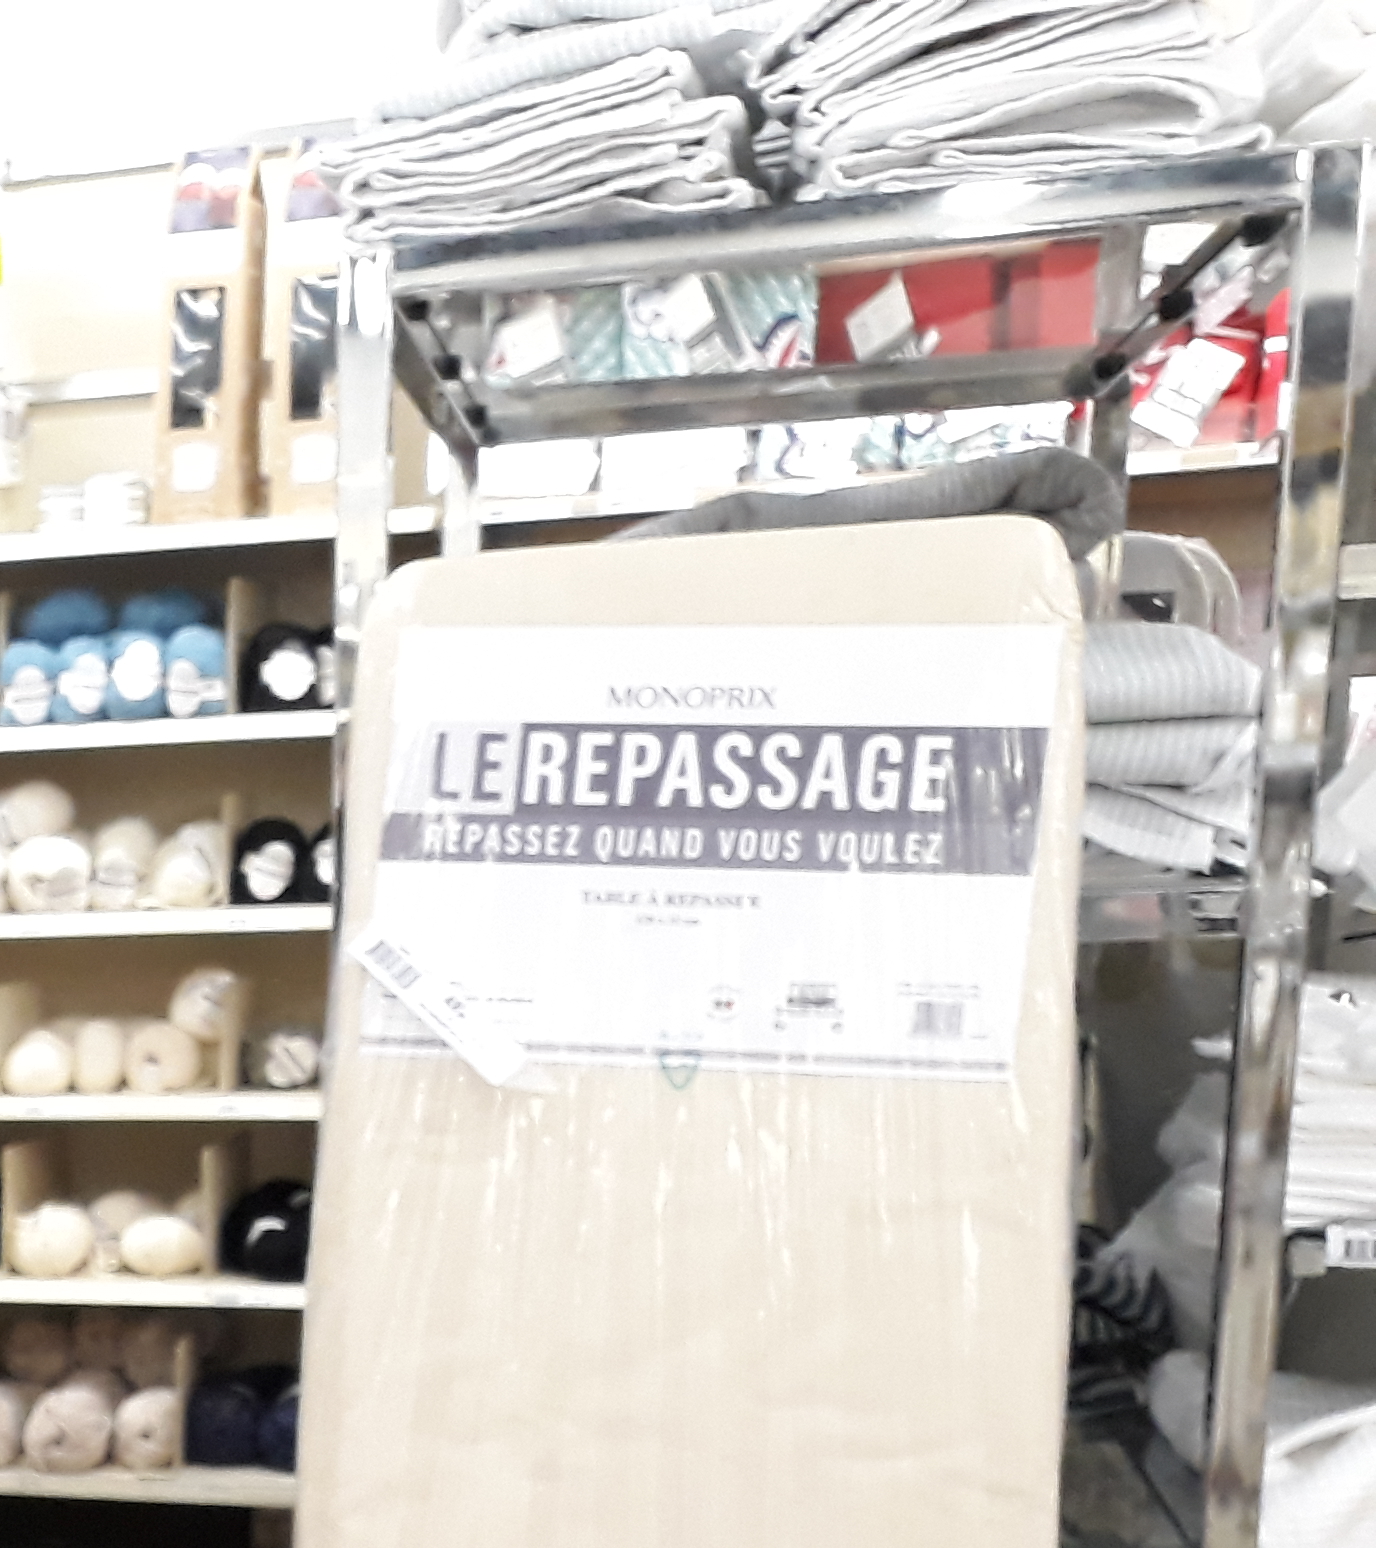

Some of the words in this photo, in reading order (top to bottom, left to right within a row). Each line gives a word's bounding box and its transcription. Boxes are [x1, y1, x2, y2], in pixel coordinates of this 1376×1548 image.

[608, 684, 778, 710] MONOPRIX
[433, 731, 508, 802] LE
[521, 730, 954, 812] REPASSAGE
[422, 821, 583, 858] REPASSEZ
[594, 824, 705, 864] QUAND
[716, 826, 803, 863] VOUS
[816, 829, 945, 866] VOULEZ
